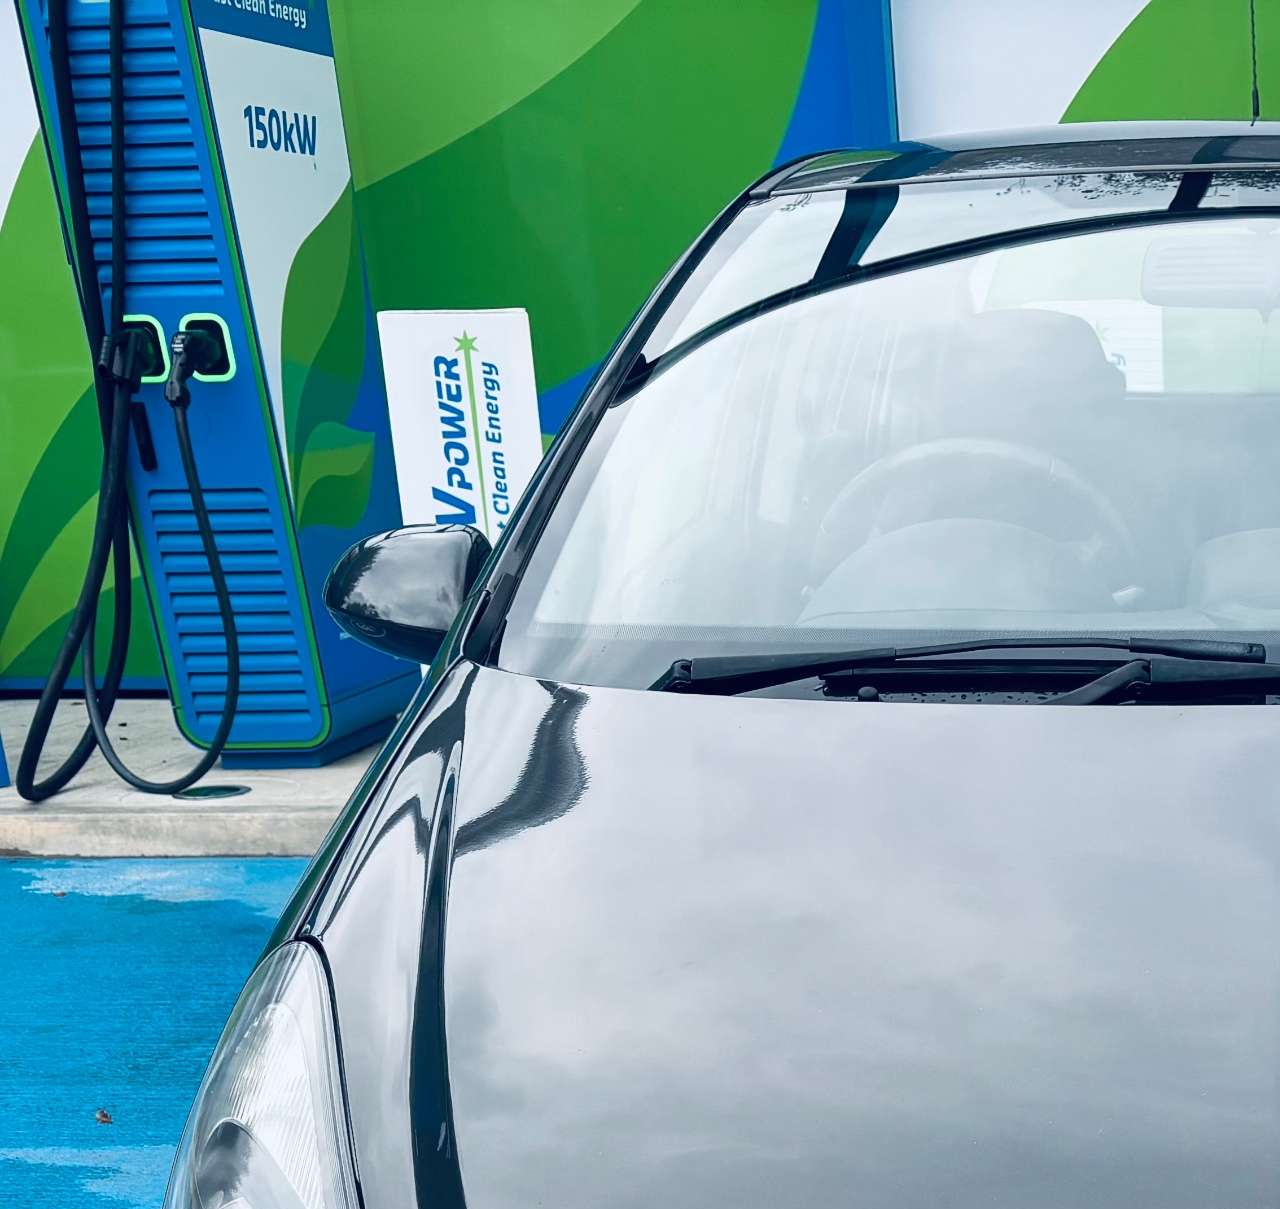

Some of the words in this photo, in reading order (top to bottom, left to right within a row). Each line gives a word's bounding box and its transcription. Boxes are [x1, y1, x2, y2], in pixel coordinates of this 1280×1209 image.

[268, 0, 307, 29] Energy
[243, 104, 317, 156] 150kW
[481, 361, 502, 444] Energy
[488, 450, 511, 516] Clean
